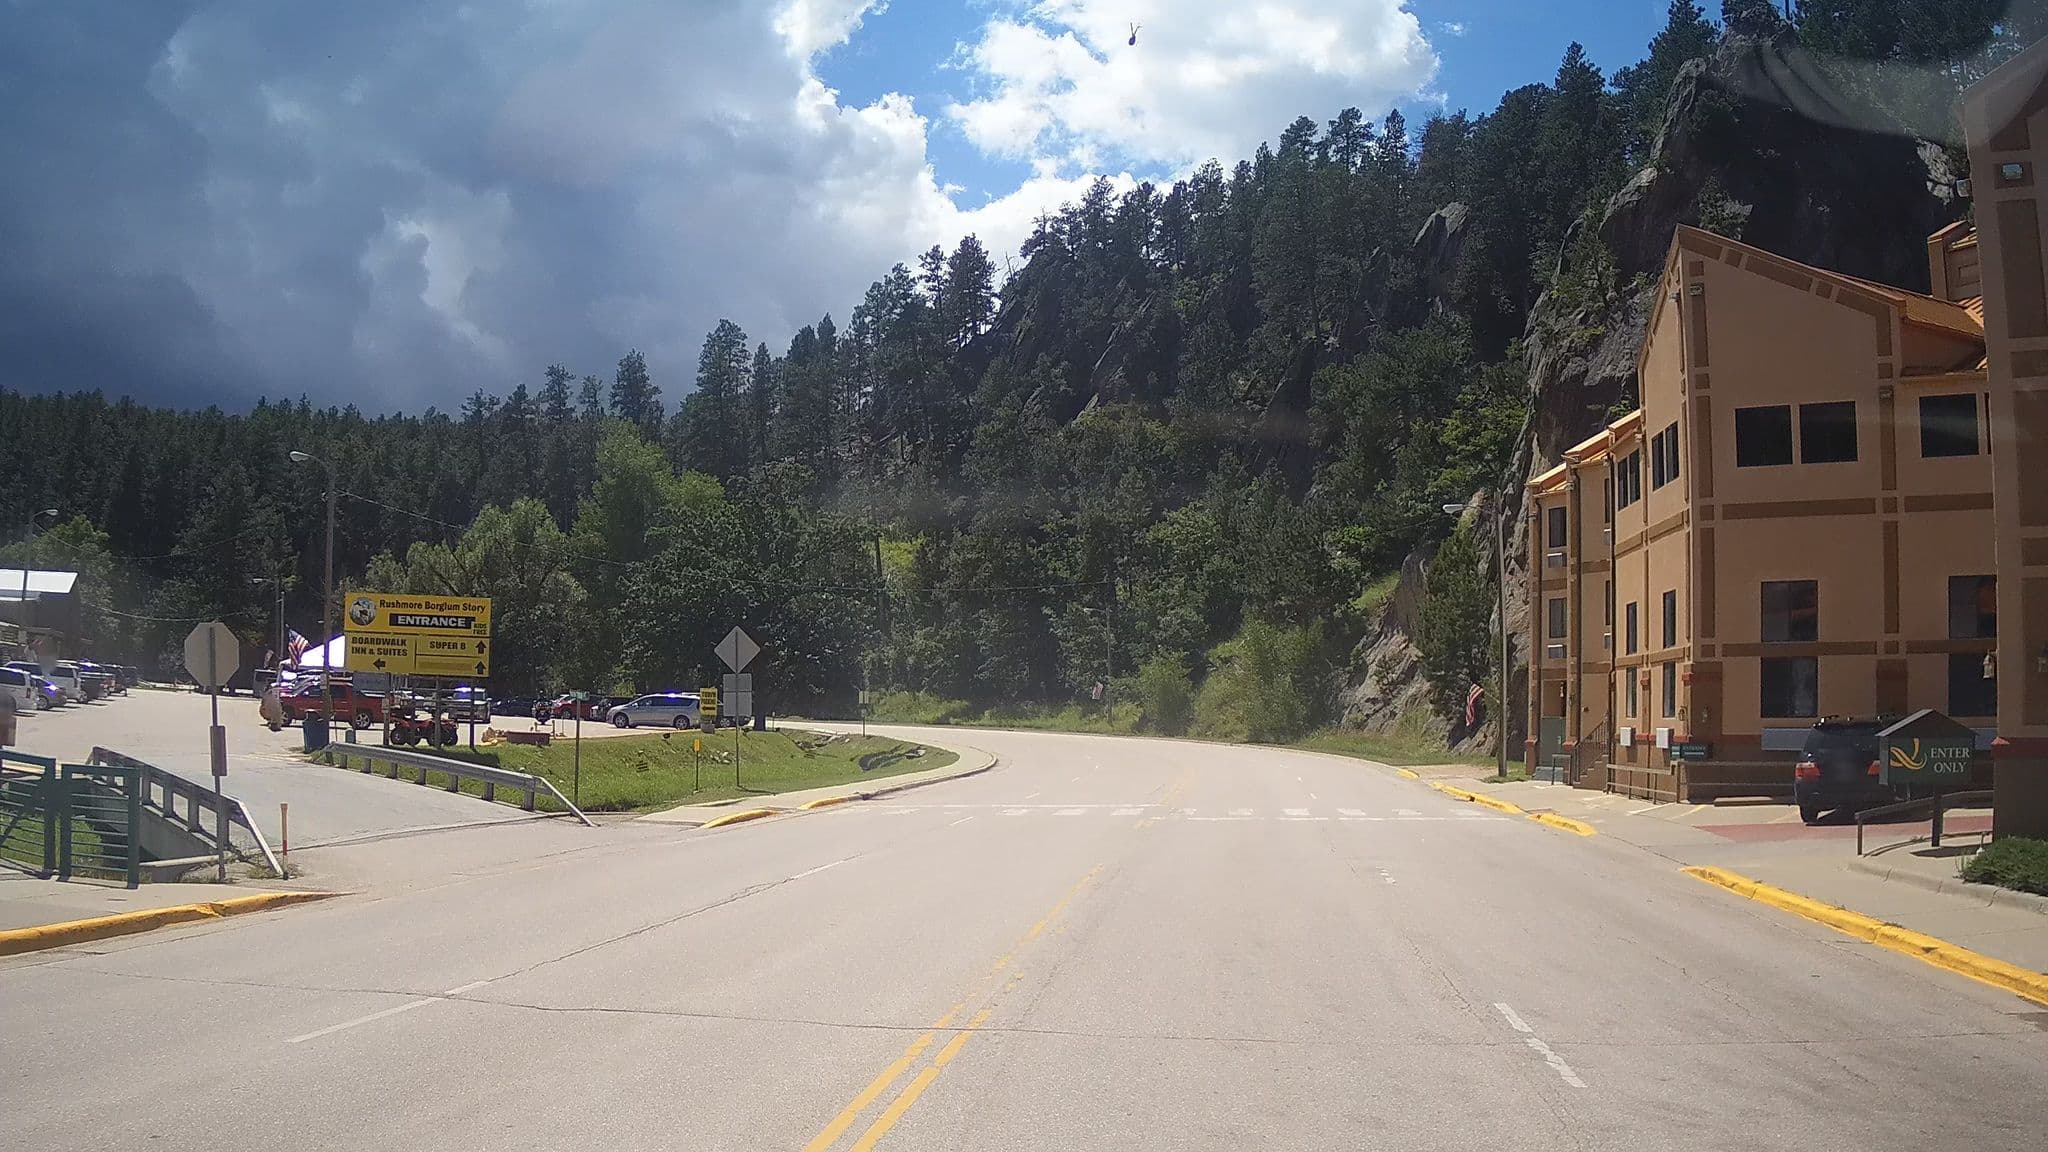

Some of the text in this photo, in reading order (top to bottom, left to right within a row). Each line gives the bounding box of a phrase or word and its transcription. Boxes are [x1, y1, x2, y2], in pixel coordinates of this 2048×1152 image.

[379, 599, 486, 614] Rushmore Borglum Story
[397, 615, 467, 627] ENTRANCE
[351, 636, 407, 647] BOARDWALK
[429, 641, 459, 650] SUPER
[351, 647, 367, 655] INN
[377, 648, 408, 656] SUITES
[1930, 747, 1970, 758] ENTER
[1934, 761, 1967, 773] ONLY
